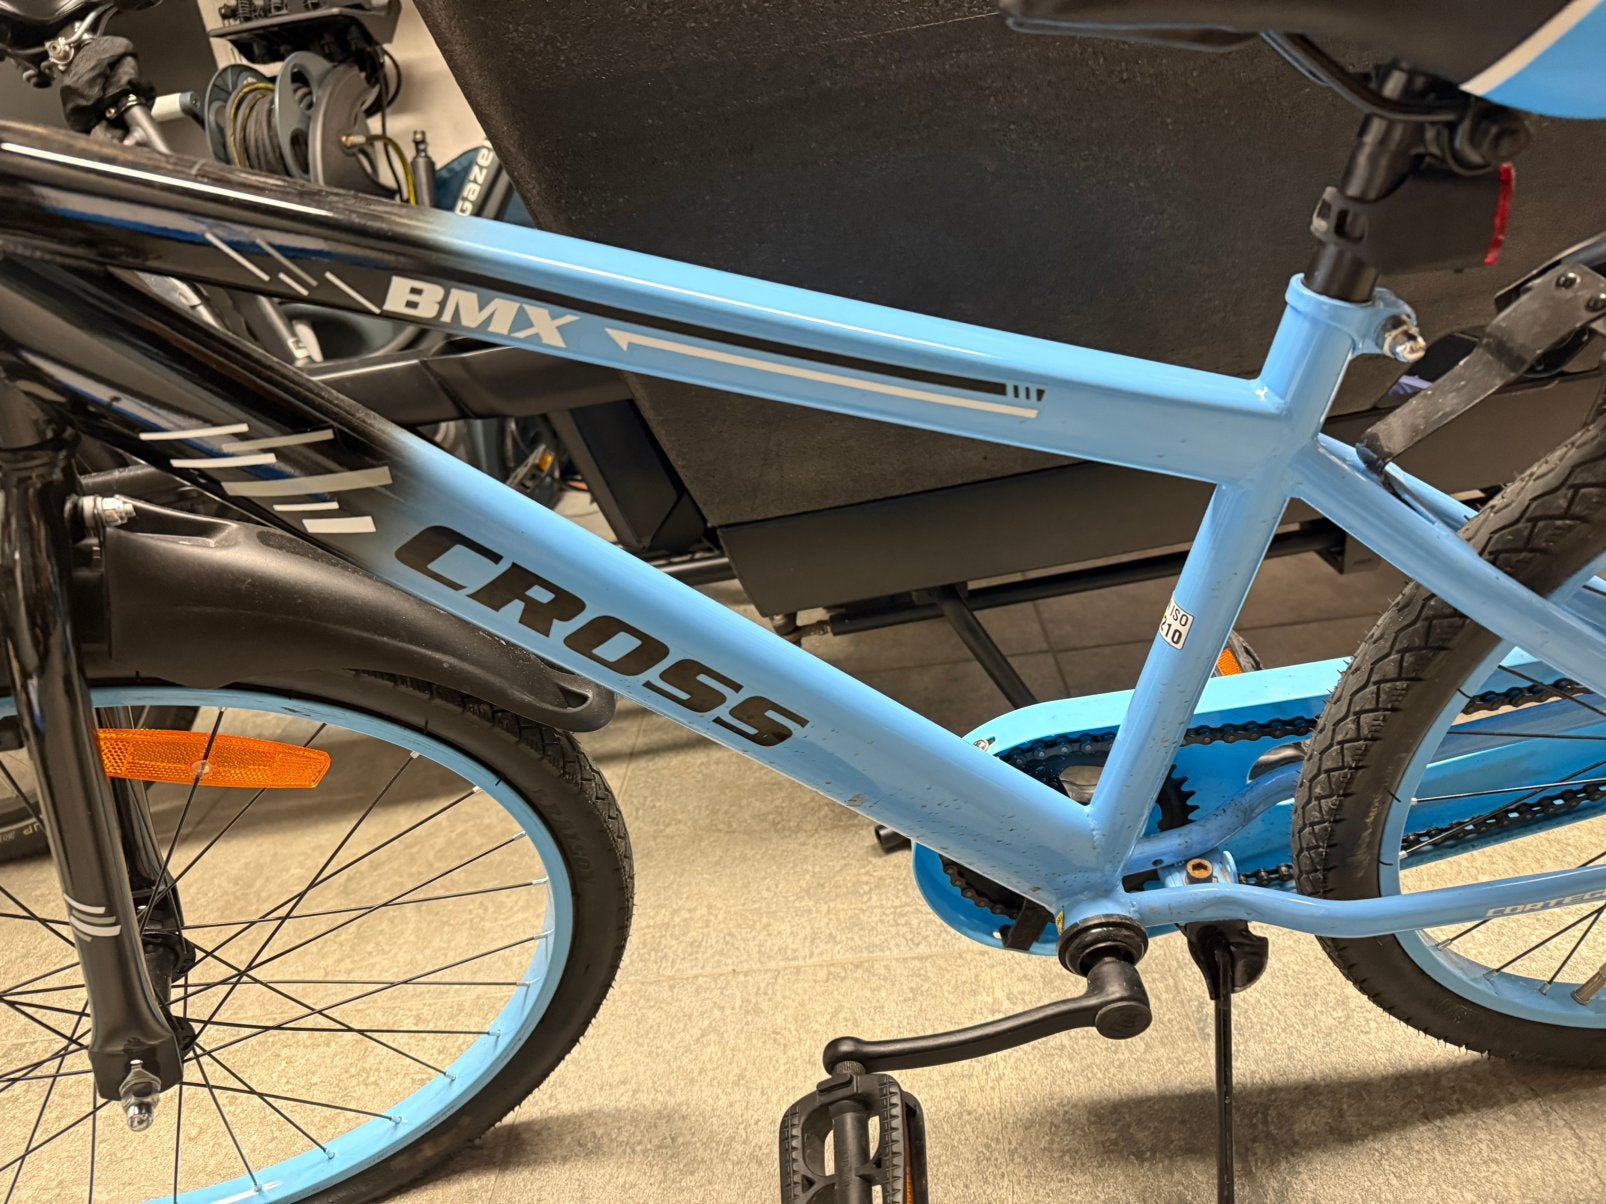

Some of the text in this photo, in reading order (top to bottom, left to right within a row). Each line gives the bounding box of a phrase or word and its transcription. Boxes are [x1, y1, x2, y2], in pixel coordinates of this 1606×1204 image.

[453, 143, 495, 217] Gaze
[382, 275, 581, 348] BMX
[395, 525, 810, 747] CROSS
[1169, 604, 1189, 627] ISO
[1486, 888, 1606, 917] CORTEG
